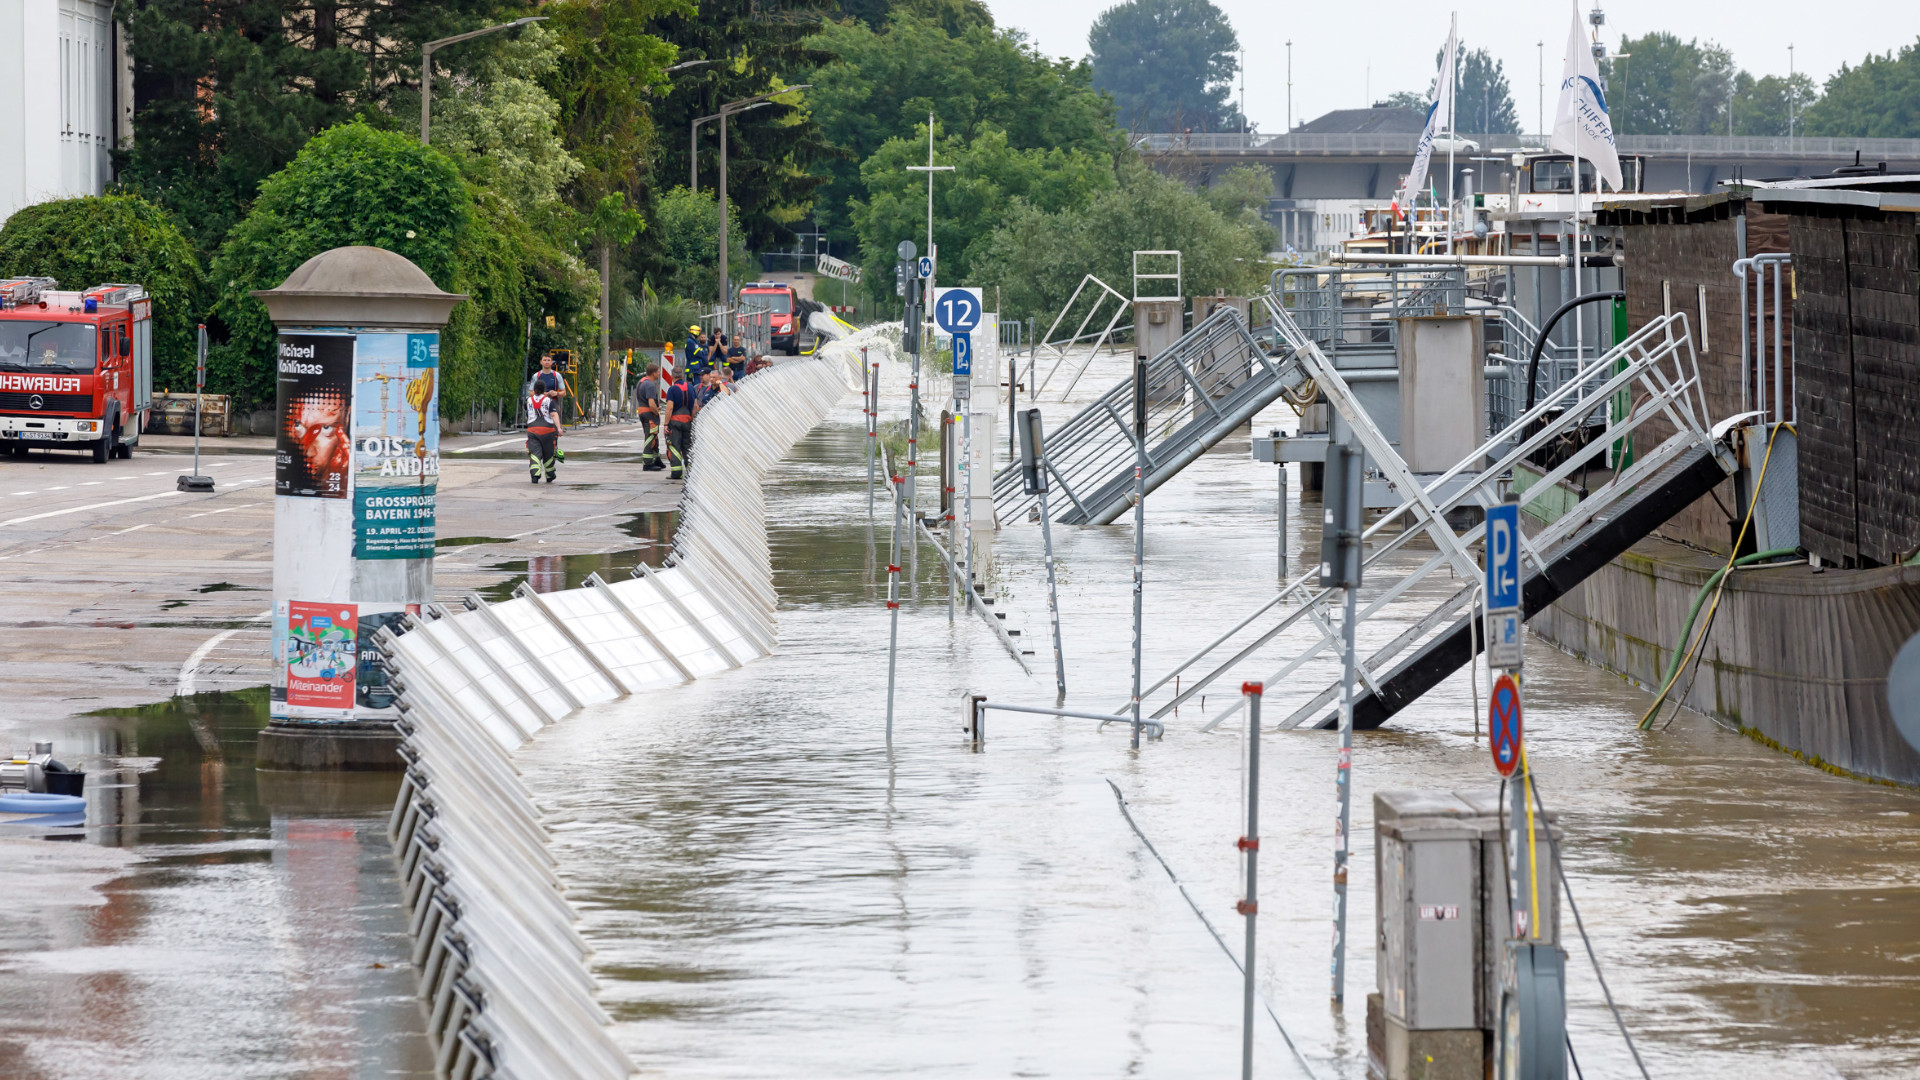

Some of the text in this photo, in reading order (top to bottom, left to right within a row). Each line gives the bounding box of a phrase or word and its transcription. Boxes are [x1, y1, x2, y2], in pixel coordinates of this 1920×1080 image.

[921, 262, 931, 274] 14
[943, 300, 973, 327] 12
[279, 343, 315, 358] Michael
[279, 359, 323, 375] Kohlhaas
[364, 437, 403, 456] OIS
[328, 472, 341, 481] 23
[328, 483, 340, 492] 24
[365, 508, 411, 520] BAYERN
[366, 527, 378, 535] 19.
[380, 527, 402, 535] APRIL
[1492, 518, 1511, 597] P
[289, 679, 343, 693] Miteinander
